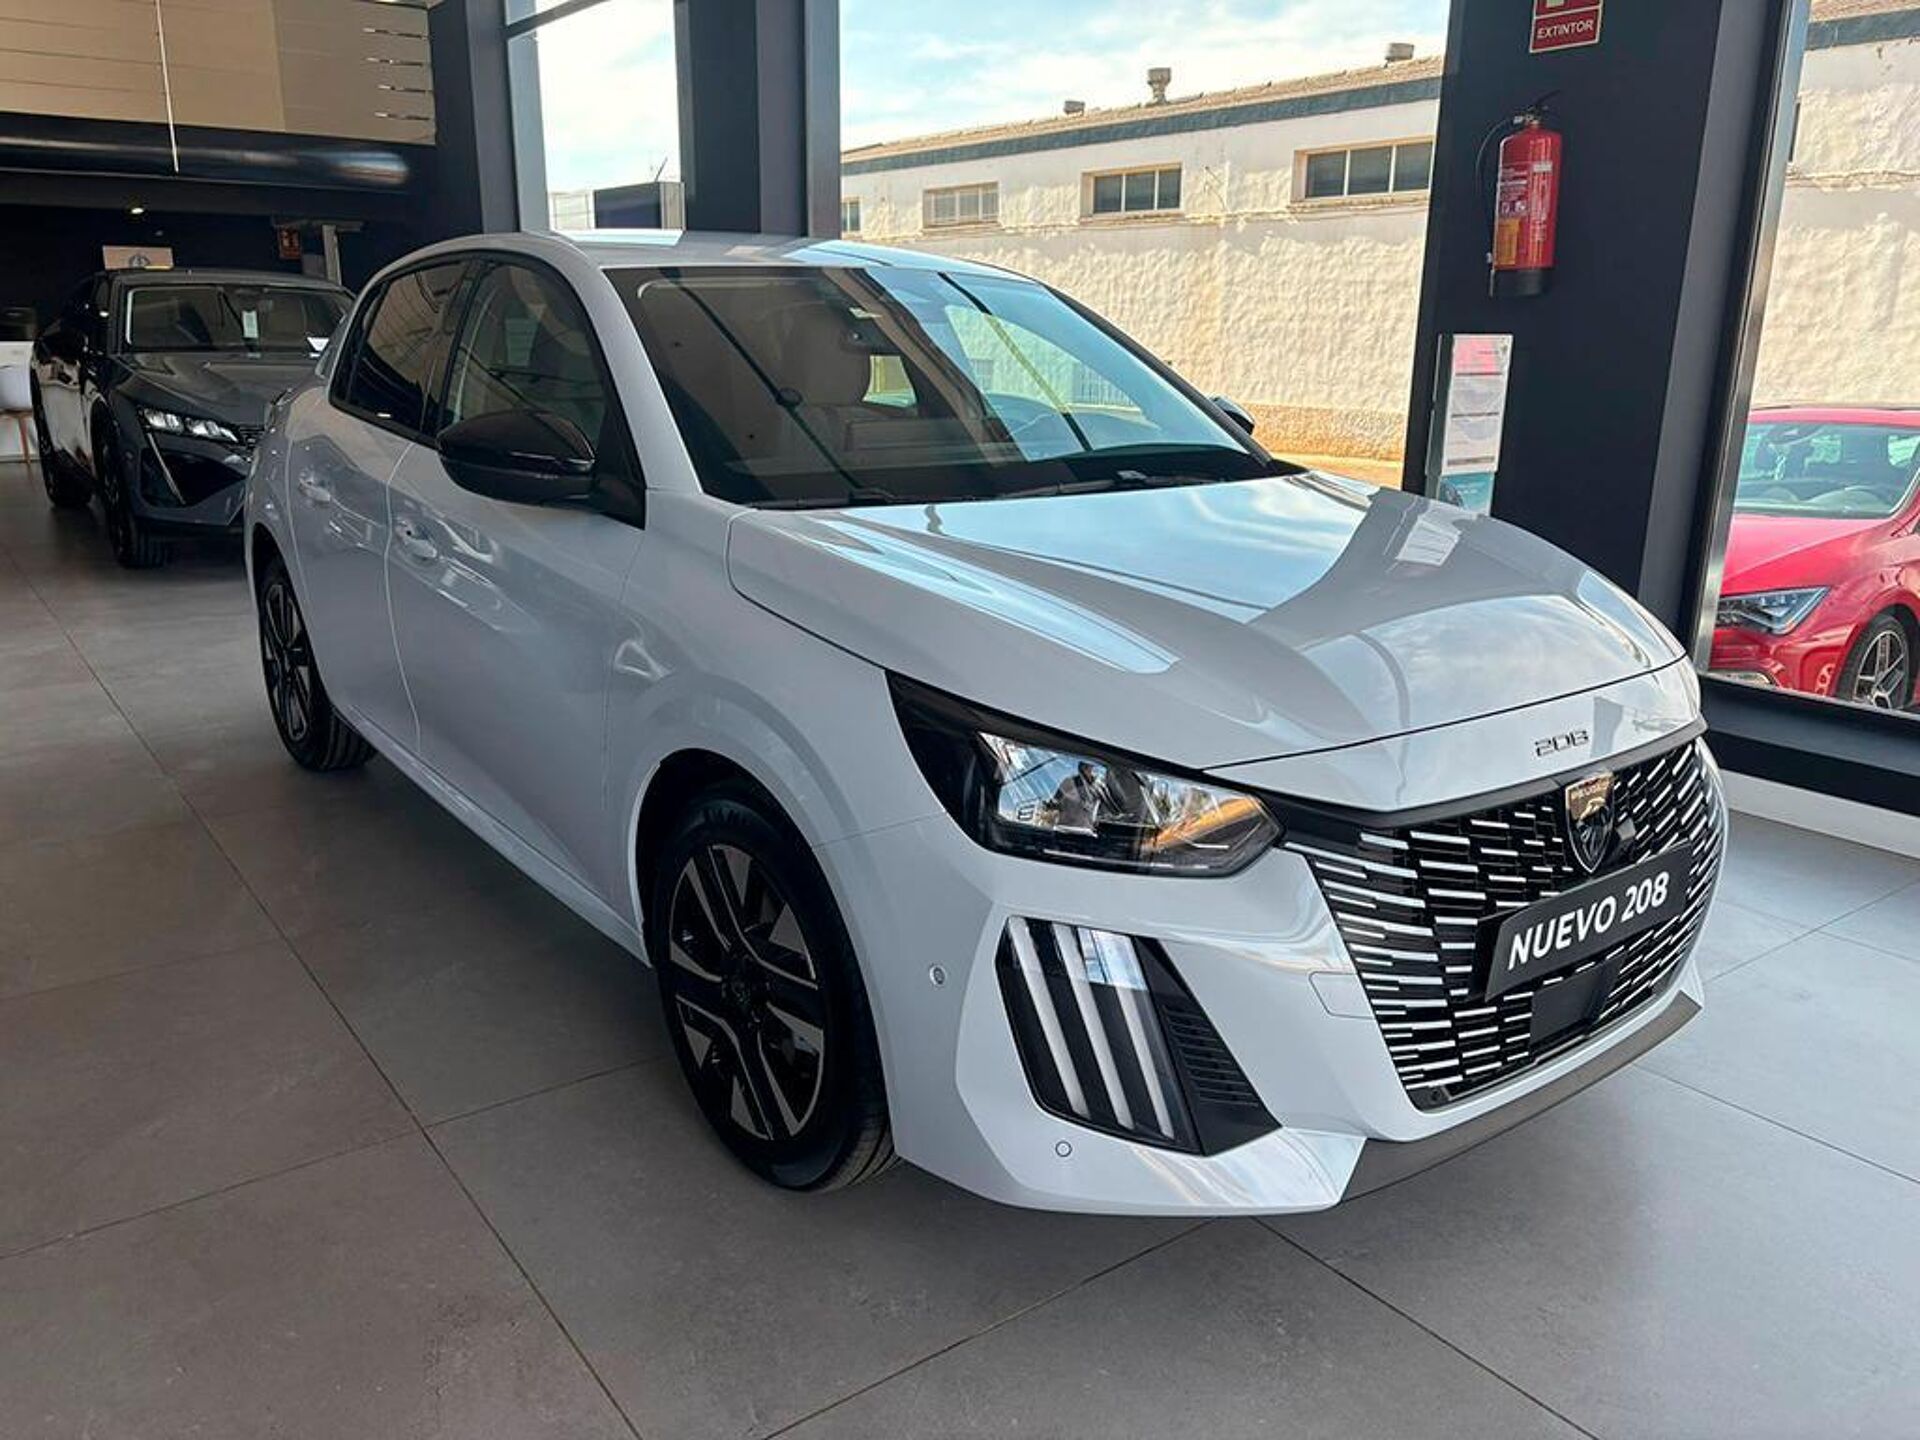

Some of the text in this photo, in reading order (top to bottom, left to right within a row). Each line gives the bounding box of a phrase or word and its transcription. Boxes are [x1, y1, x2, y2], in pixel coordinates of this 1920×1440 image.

[1536, 18, 1594, 39] EXTINTOR
[1534, 730, 1588, 757] 208
[1507, 871, 1670, 971] NUEVO 208
